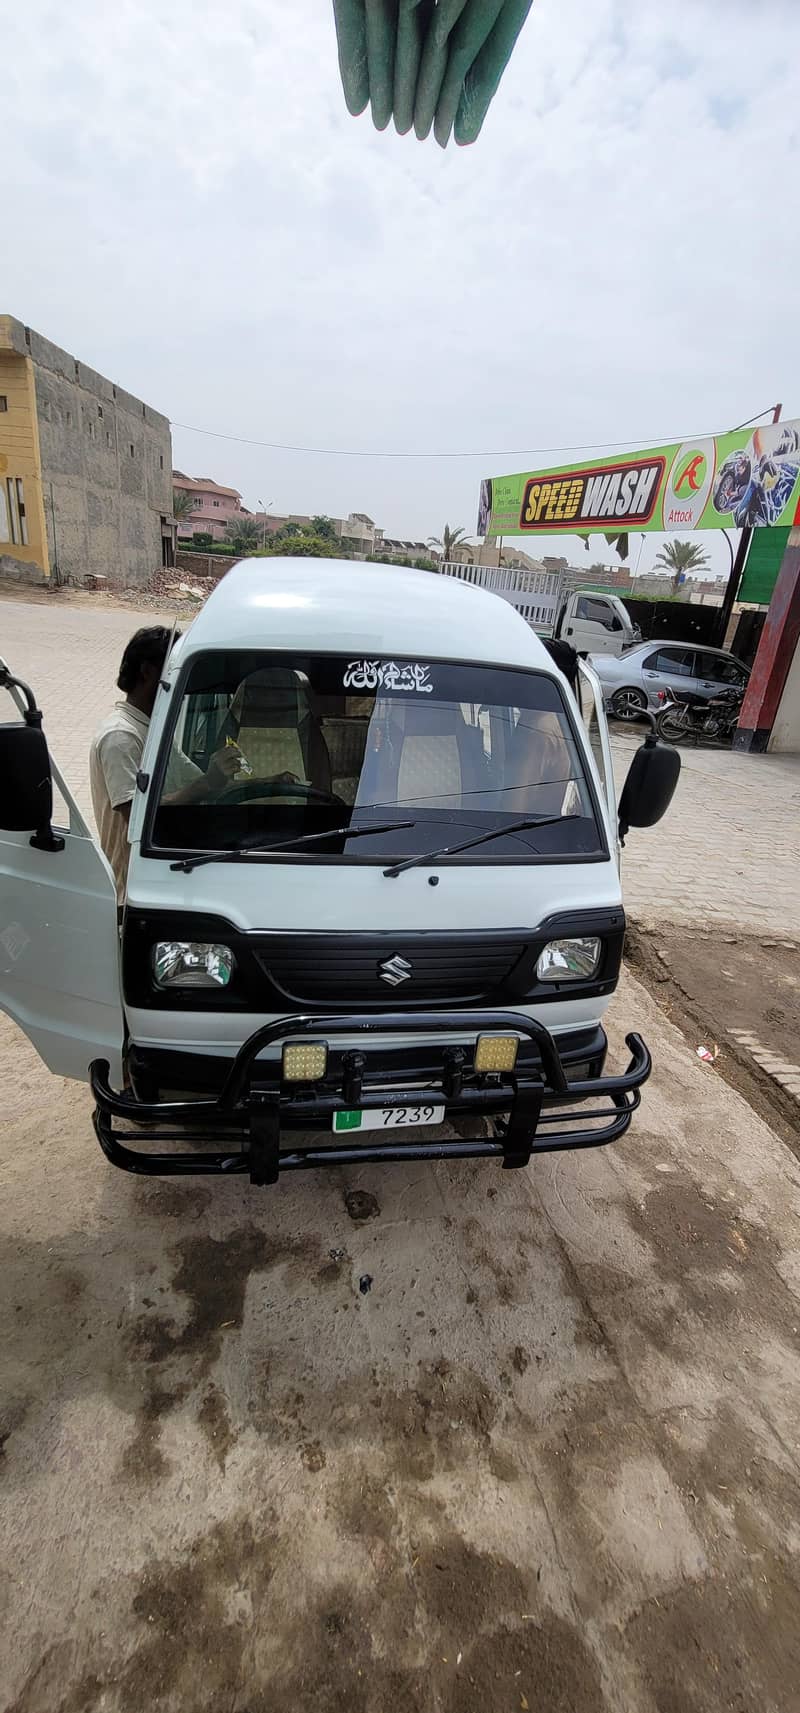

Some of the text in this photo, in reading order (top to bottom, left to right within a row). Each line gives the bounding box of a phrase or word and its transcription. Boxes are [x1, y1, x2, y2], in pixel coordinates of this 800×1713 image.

[526, 468, 658, 521] SPEED WASH
[669, 508, 693, 522] Attock
[382, 1107, 434, 1125] 7239
